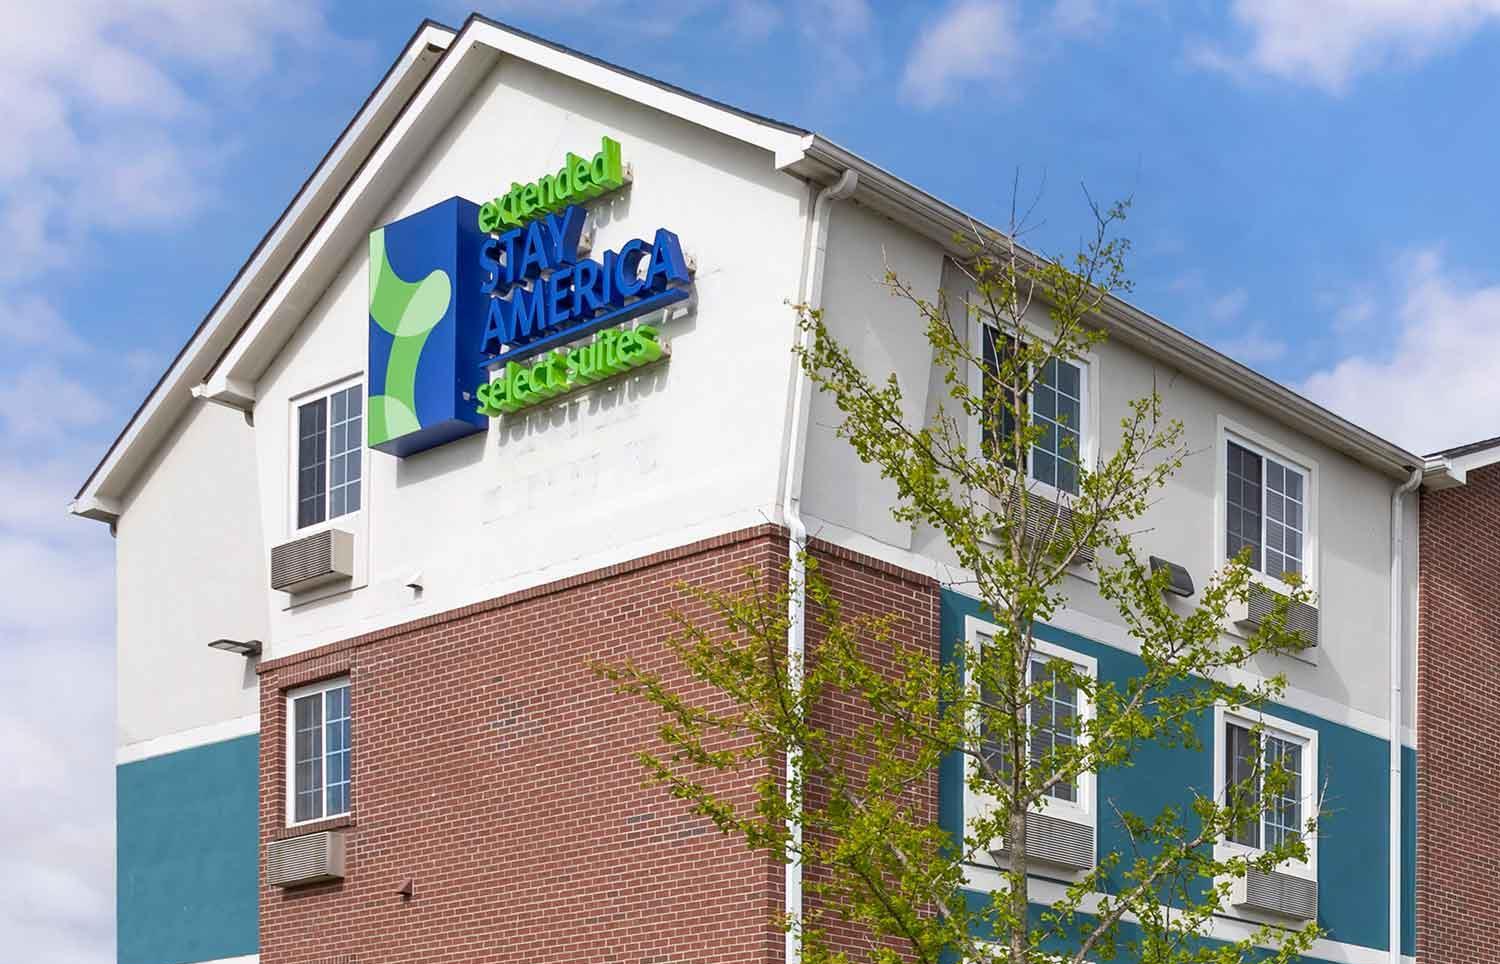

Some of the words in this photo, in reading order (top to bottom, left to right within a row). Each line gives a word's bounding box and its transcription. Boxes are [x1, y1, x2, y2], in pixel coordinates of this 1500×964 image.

[478, 136, 623, 233] extended
[480, 206, 587, 294] STAY
[481, 228, 689, 353] AMERICA
[477, 352, 569, 417] select
[566, 324, 661, 382] suites
